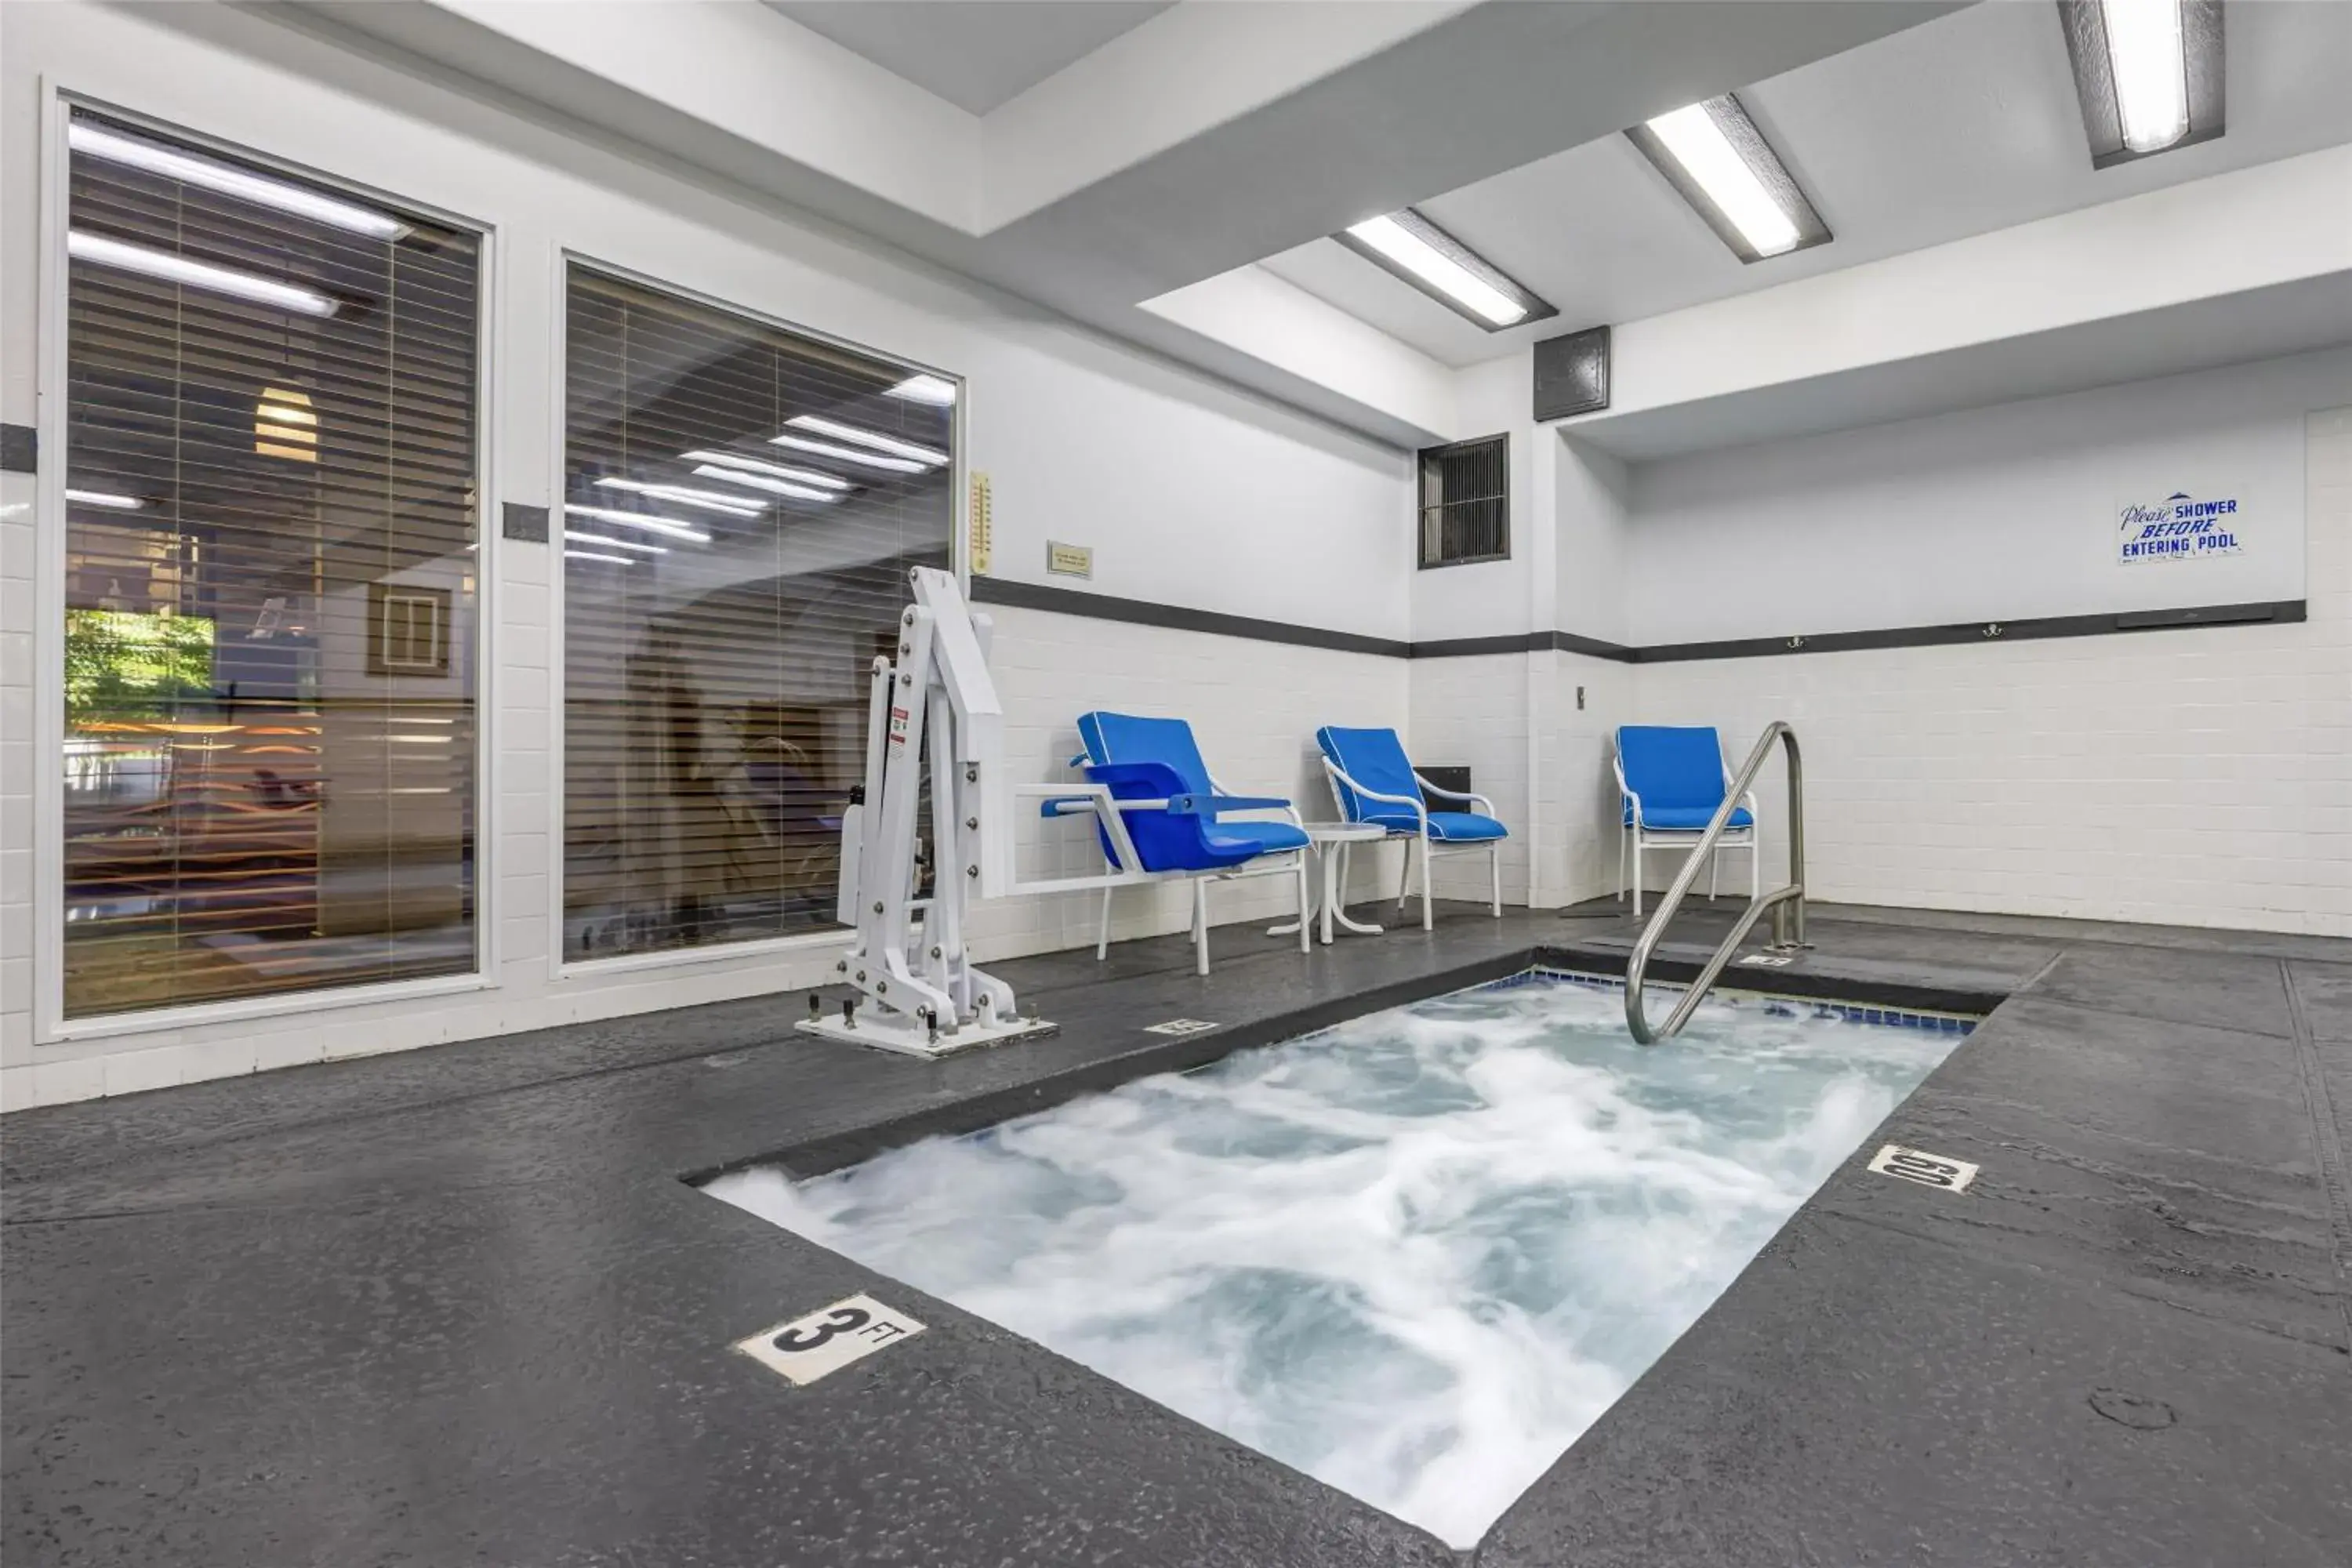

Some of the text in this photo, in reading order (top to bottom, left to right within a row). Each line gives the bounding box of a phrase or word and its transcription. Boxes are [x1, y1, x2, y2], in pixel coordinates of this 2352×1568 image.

[2120, 499, 2237, 531] Please SHOWER
[2140, 518, 2217, 539] BEFORE
[2122, 534, 2238, 557] ENTERING POOL
[773, 1308, 907, 1352] 3 FT
